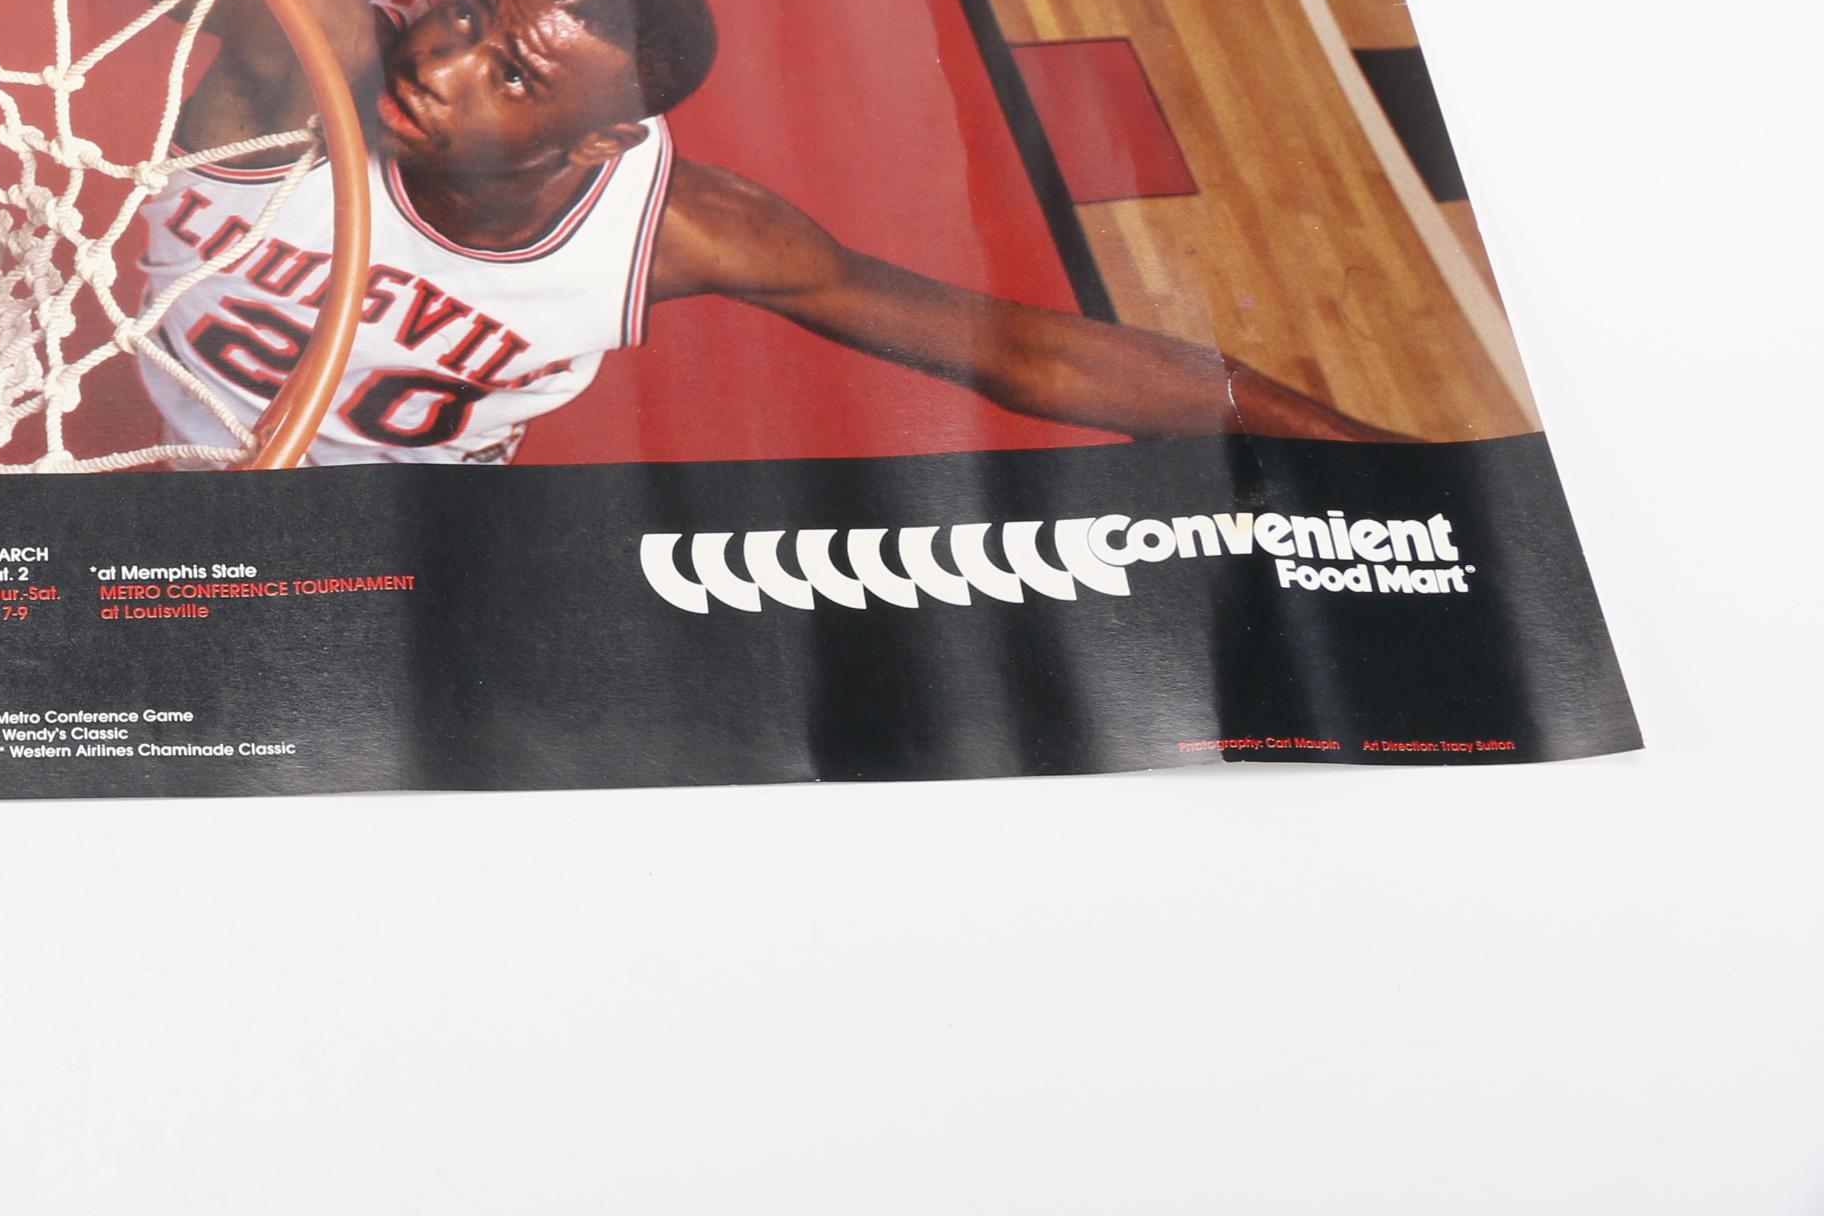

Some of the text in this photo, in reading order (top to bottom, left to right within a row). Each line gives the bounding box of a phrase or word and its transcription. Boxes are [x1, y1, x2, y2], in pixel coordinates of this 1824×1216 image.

[187, 295, 487, 448] 20
[121, 563, 257, 582] Memphis State
[1275, 559, 1373, 592] Food
[100, 581, 288, 600] METRO CONFERENCE
[293, 576, 414, 595] TOURNAMENT
[2, 606, 28, 620] 7-9
[100, 603, 209, 619] at Louisville
[45, 710, 139, 723] Conference
[143, 709, 194, 722] Game
[2, 727, 128, 743] Wendy's Classic
[9, 741, 296, 758] Western Airlines Chaminade Classic
[1440, 740, 1473, 753] Tracy
[1476, 739, 1516, 751] Sutton
